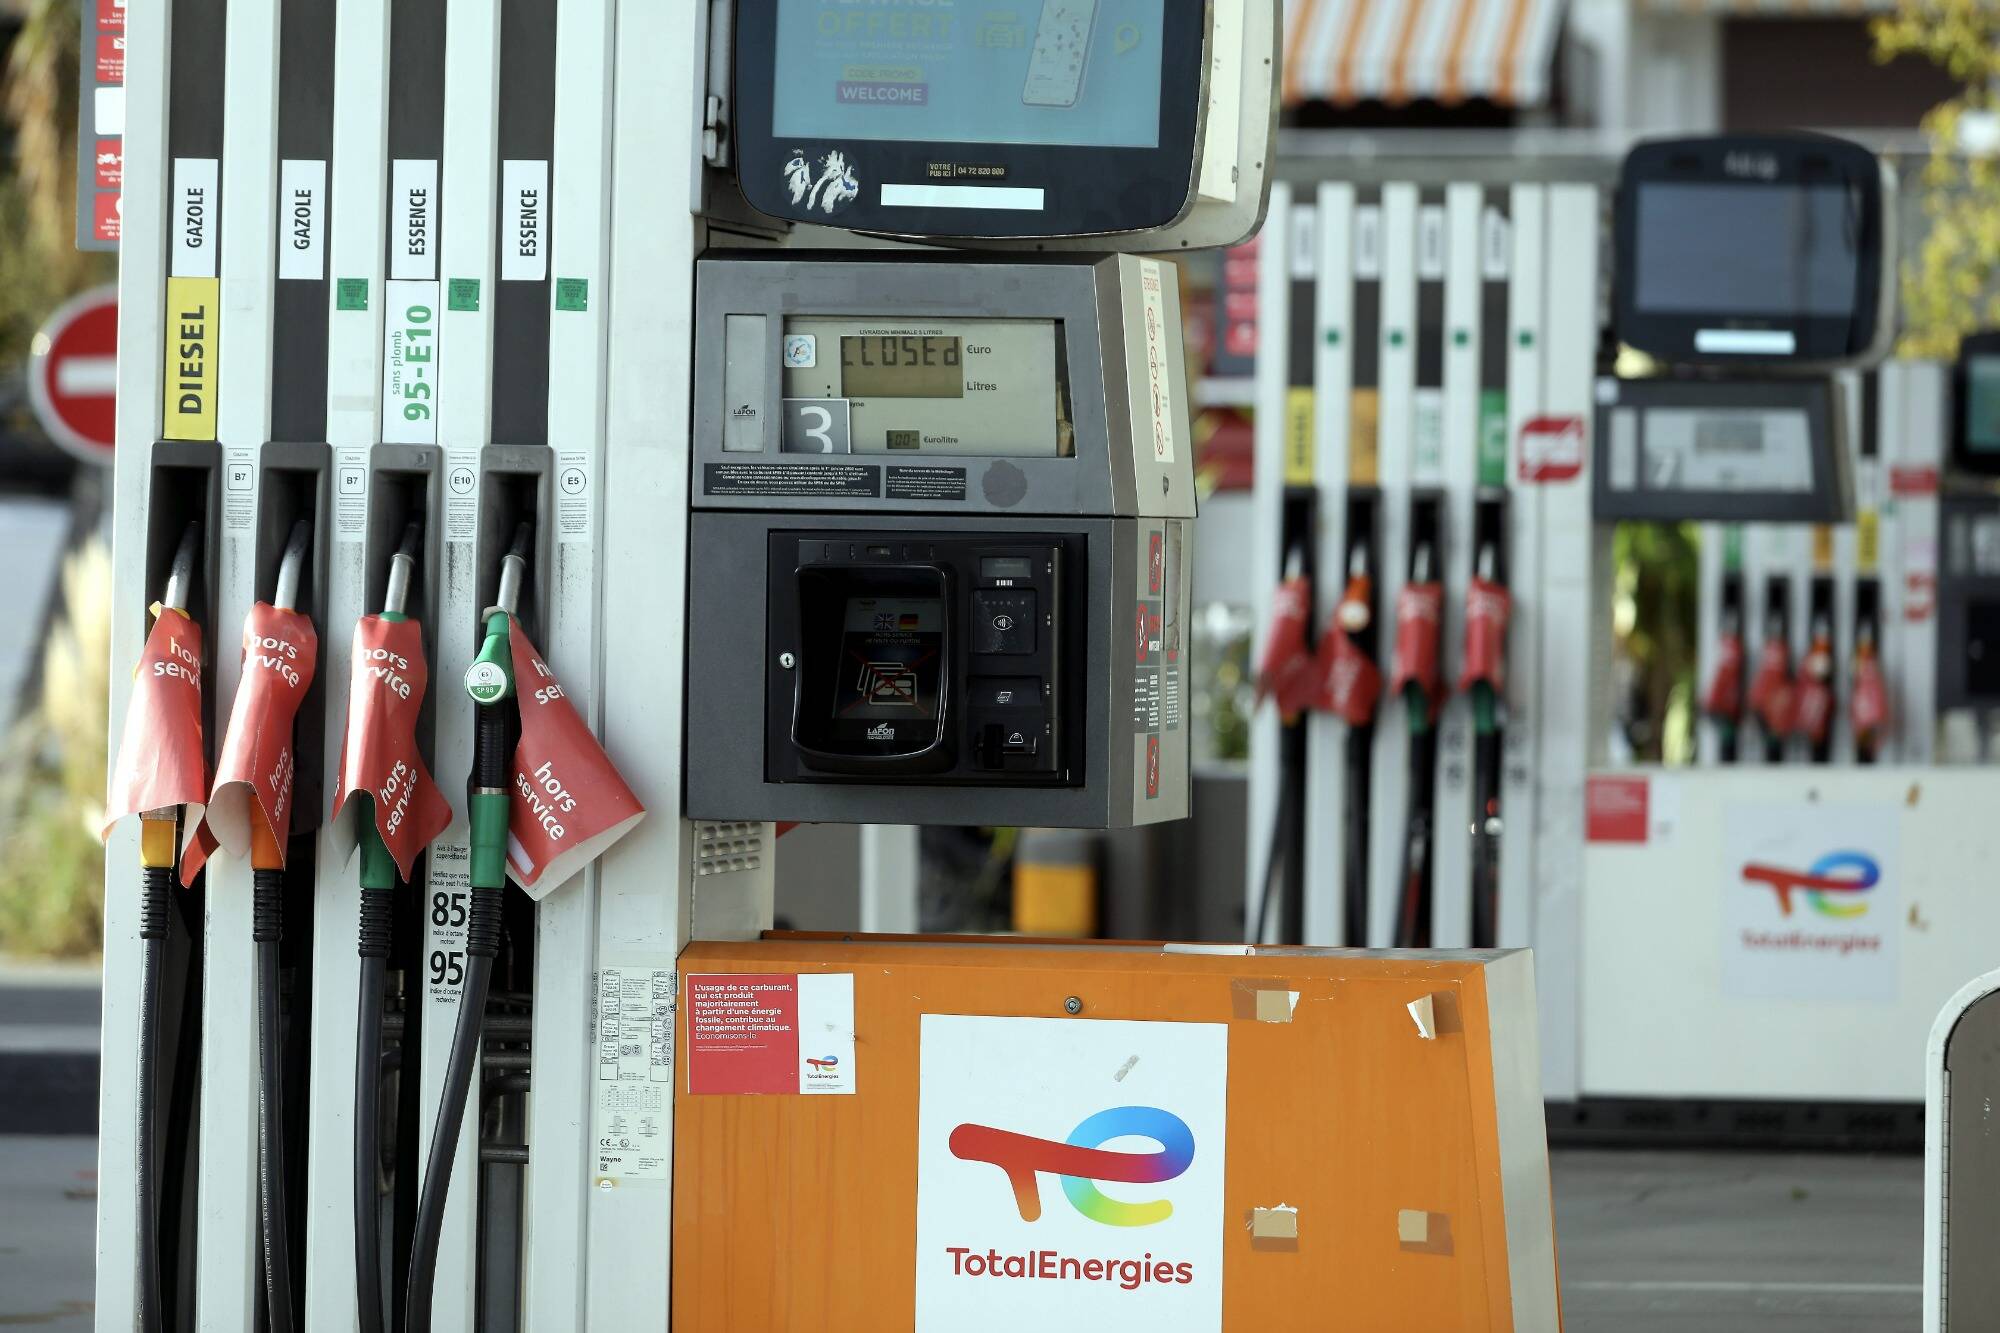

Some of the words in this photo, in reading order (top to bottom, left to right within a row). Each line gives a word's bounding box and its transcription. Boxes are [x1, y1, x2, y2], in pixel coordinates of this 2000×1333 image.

[842, 86, 923, 101] WELCOME
[929, 163, 951, 171] VOTRE
[957, 166, 967, 174] 04
[968, 167, 977, 175] 72
[186, 187, 204, 248] GAZOLE
[293, 189, 312, 250] GAZOLE
[408, 188, 427, 256] ESSENCE
[519, 188, 538, 258] ESSENCE
[178, 304, 205, 414] DIESEL
[391, 330, 403, 366] plomb
[403, 305, 431, 421] 95-E10
[392, 367, 401, 395] sans
[967, 381, 997, 391] Litres
[800, 405, 833, 454] 3
[234, 472, 246, 481] B7
[346, 476, 358, 485] B7
[454, 476, 471, 485] E10
[567, 476, 580, 485] E5
[269, 747, 288, 792] hors
[379, 759, 408, 806] hors
[386, 768, 417, 836] service
[534, 761, 577, 813] hors
[516, 772, 566, 841] service
[432, 892, 467, 927] 85
[430, 951, 463, 985] 95
[694, 984, 725, 992] L'usage
[750, 983, 793, 992] carburant,
[694, 992, 708, 1000] qui
[724, 992, 754, 1000] produit
[695, 1000, 759, 1008] majoritairement
[695, 1016, 723, 1024] fossile,
[695, 1024, 746, 1032] changement
[747, 1024, 792, 1032] climatique.
[702, 1008, 725, 1016] partir
[751, 1008, 782, 1016] énergie
[946, 1247, 1193, 1290] TotalEnergies
